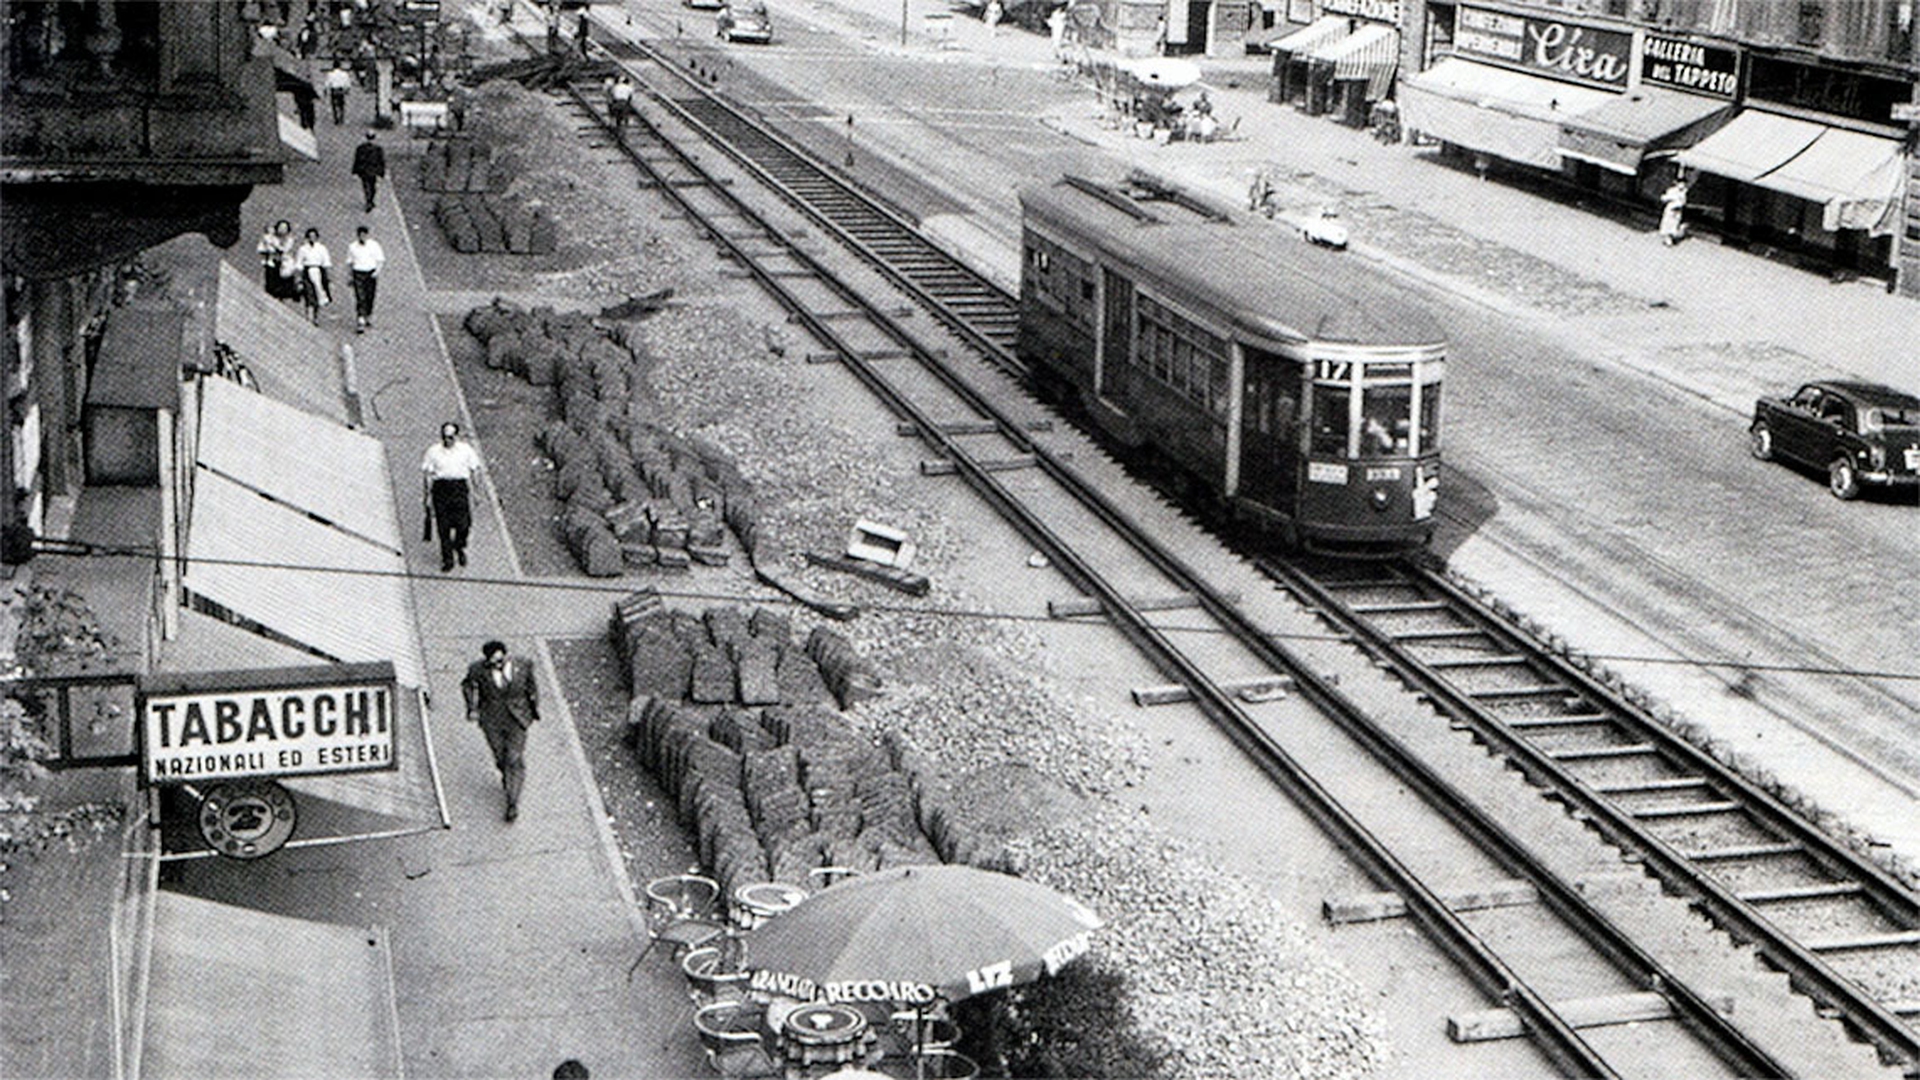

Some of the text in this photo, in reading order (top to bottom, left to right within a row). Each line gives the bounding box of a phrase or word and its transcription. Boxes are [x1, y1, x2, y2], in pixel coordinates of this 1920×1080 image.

[1644, 37, 1705, 66] GALLERIA
[1674, 64, 1737, 94] TAPPETO
[1320, 359, 1348, 380] 17
[152, 690, 387, 748] TABACCHI
[155, 744, 389, 776] NAZIONALI ED ESTERI
[826, 980, 935, 1003] RECOARO
